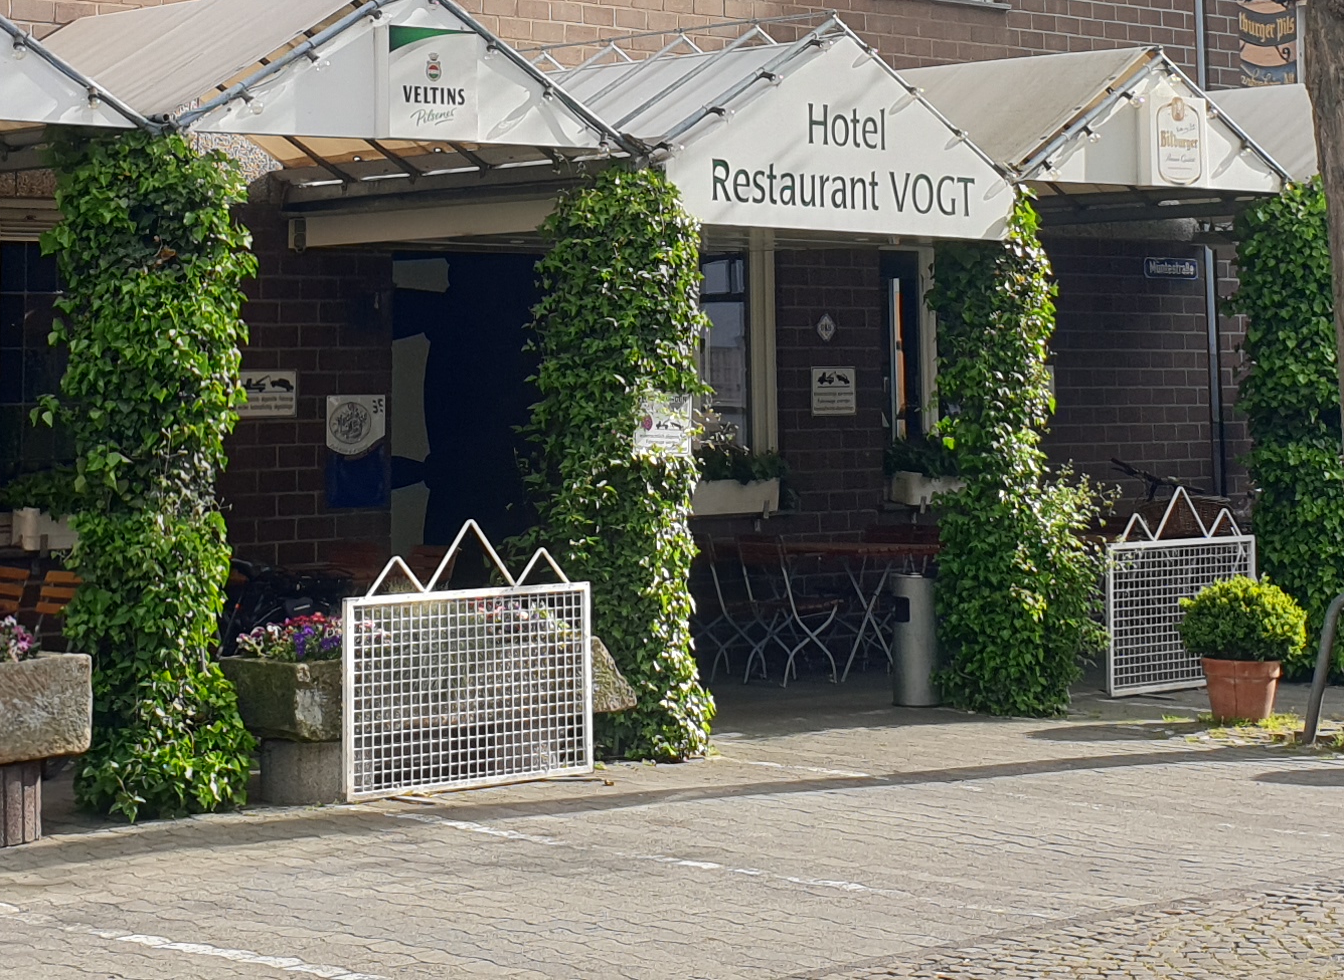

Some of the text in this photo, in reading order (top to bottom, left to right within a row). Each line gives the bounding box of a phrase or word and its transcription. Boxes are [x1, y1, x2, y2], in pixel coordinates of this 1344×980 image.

[402, 85, 466, 106] VELTINS
[410, 107, 457, 126] Pilsener
[808, 103, 887, 151] Hotel
[1160, 130, 1199, 151] Bitburger
[712, 158, 976, 217] Restaurant VOGT
